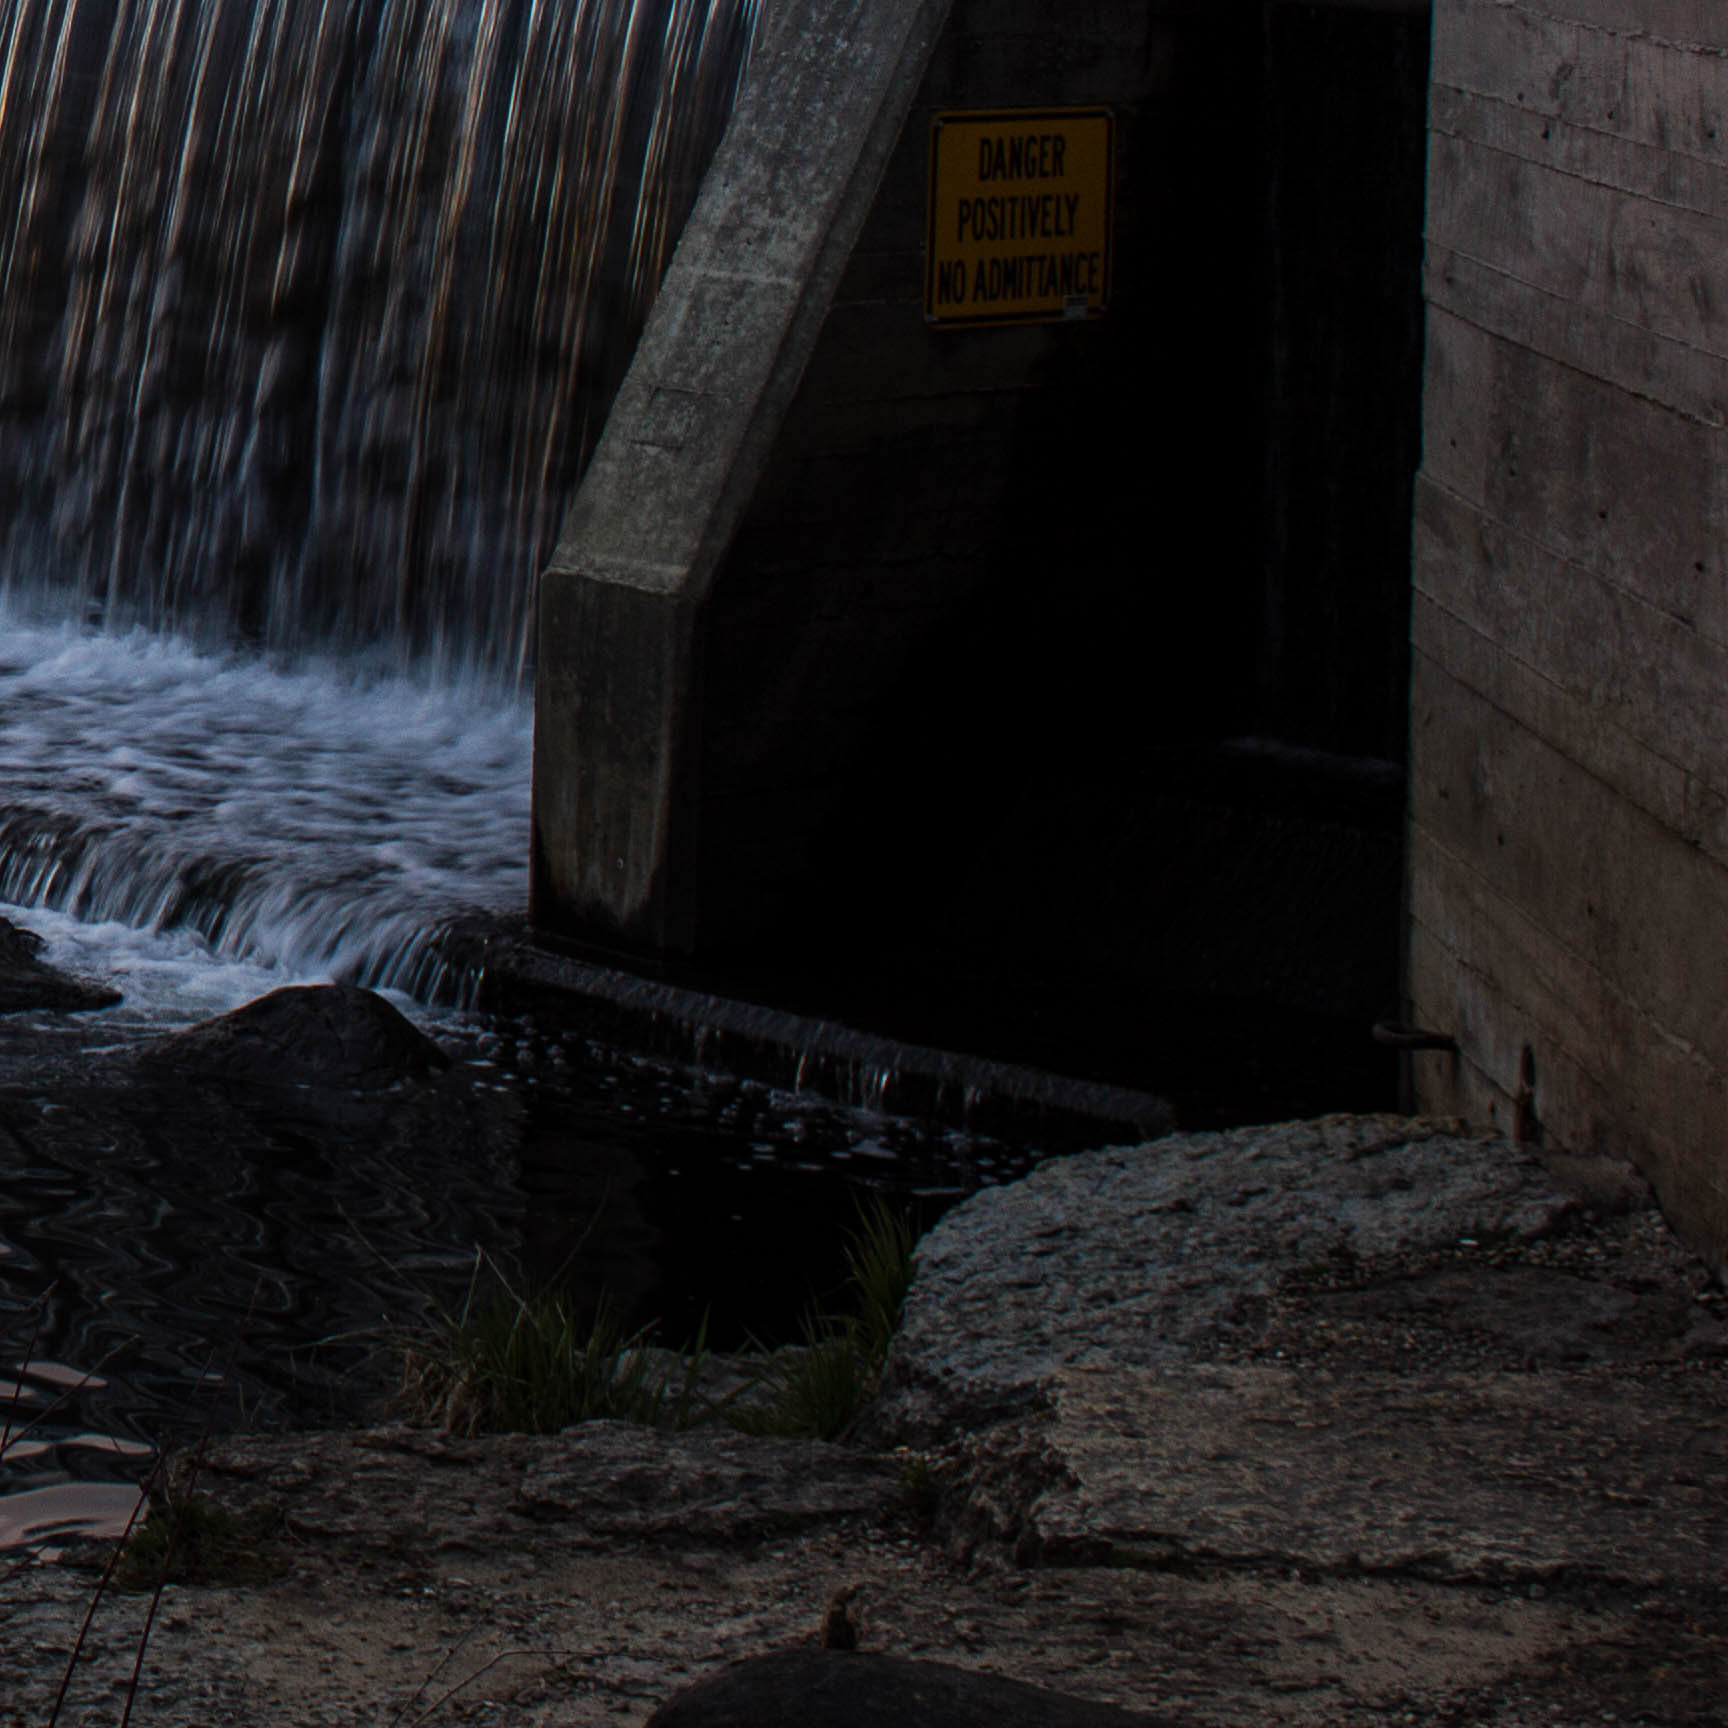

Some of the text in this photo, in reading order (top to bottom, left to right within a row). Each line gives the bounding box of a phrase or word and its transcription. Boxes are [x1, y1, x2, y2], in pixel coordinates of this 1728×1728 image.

[978, 134, 1067, 182] DANGER
[956, 193, 1081, 243] POSITIVELY
[937, 251, 1101, 305] NO ADMITTANCE
